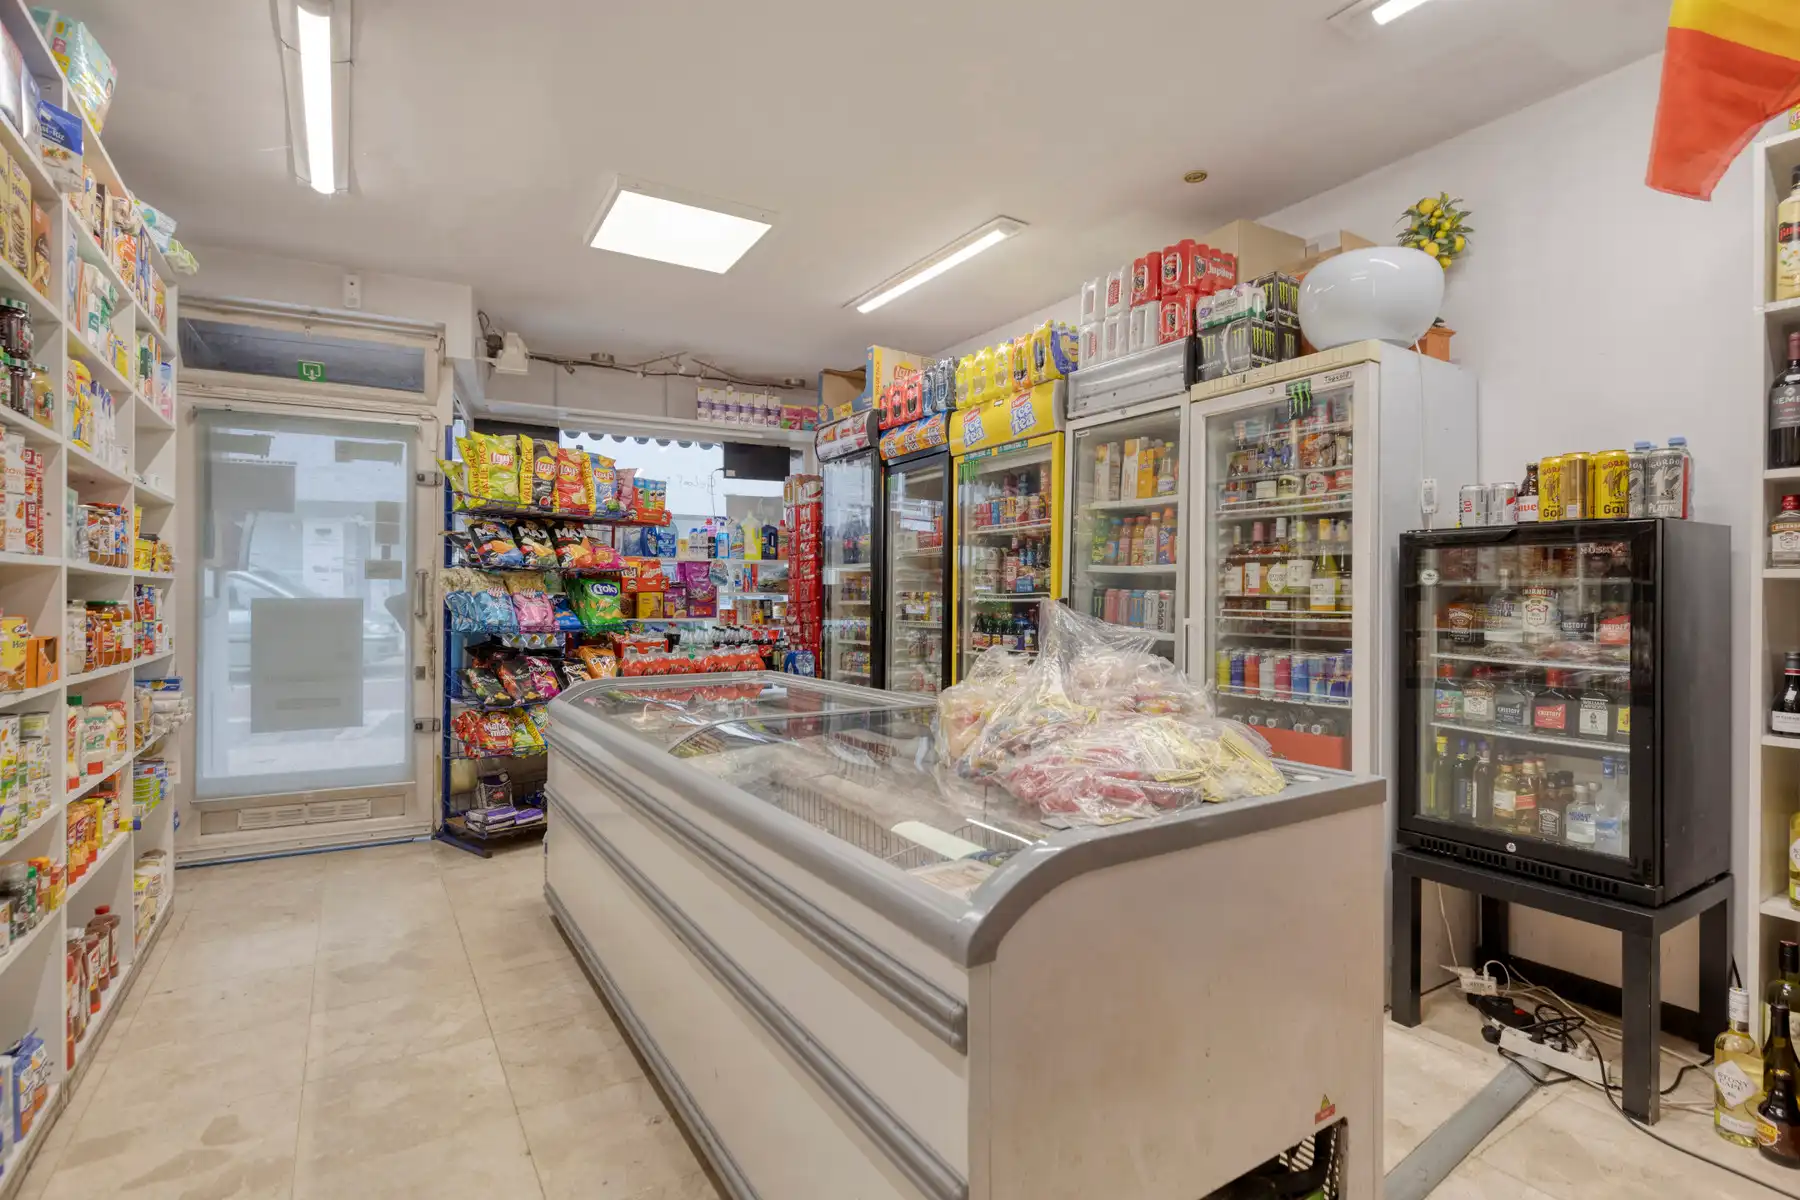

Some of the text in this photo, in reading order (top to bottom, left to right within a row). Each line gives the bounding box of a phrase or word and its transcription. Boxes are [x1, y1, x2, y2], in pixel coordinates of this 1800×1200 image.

[1207, 262, 1234, 280] Jupiler
[1011, 402, 1032, 420] Ice
[1012, 413, 1037, 435] Tea
[964, 427, 984, 447] Tea
[478, 440, 490, 495] VALUE PACK
[536, 459, 556, 475] Lay's
[560, 463, 579, 477] Lay's
[1651, 459, 1680, 469] GORDO
[523, 447, 534, 502] VALUE PACK
